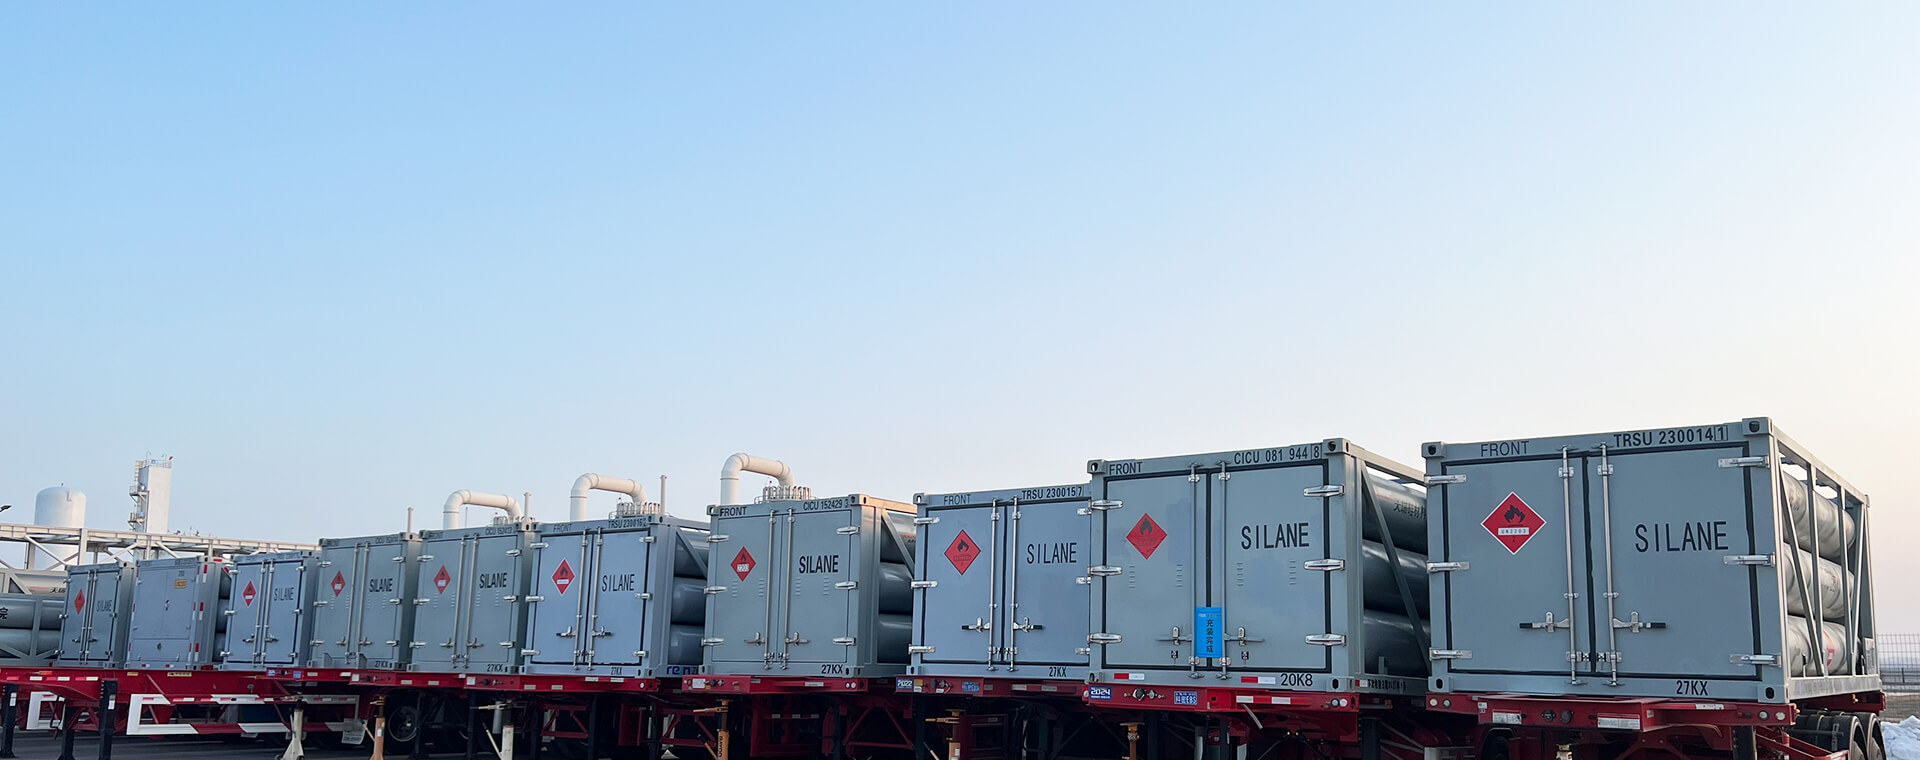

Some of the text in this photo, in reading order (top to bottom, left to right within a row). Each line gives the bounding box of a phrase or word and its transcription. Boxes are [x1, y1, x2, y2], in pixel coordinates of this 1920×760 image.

[1613, 430, 1653, 448] TRSU
[1233, 450, 1260, 465] CICU
[1265, 448, 1283, 462] 081
[1288, 446, 1309, 460] 944
[1480, 440, 1530, 458] FRONT
[1108, 461, 1143, 476] FRONT
[943, 493, 972, 506] FRONT
[1021, 489, 1044, 500] TRSU
[719, 506, 747, 517] FRONT
[803, 500, 819, 511] CICU
[821, 498, 843, 510] 152429
[553, 523, 572, 533] FRONT
[608, 520, 623, 529] TRSU
[1240, 522, 1310, 550] SILANE
[1635, 521, 1729, 552] SILANE
[1026, 542, 1077, 564] SILANE
[798, 555, 839, 574] SILANE
[369, 578, 393, 592] SILANE
[479, 573, 508, 588] SILANE
[601, 574, 635, 592] SILANE
[273, 587, 294, 601] SILANE
[96, 600, 112, 612] SILANE
[1206, 619, 1214, 653] 充装完成
[487, 663, 503, 673] 27KX
[821, 664, 843, 675] 27KX
[1048, 666, 1067, 678] 27KX
[1280, 672, 1313, 687] 20K8
[1090, 687, 1111, 695] 2024
[1676, 680, 1709, 696] 27KX
